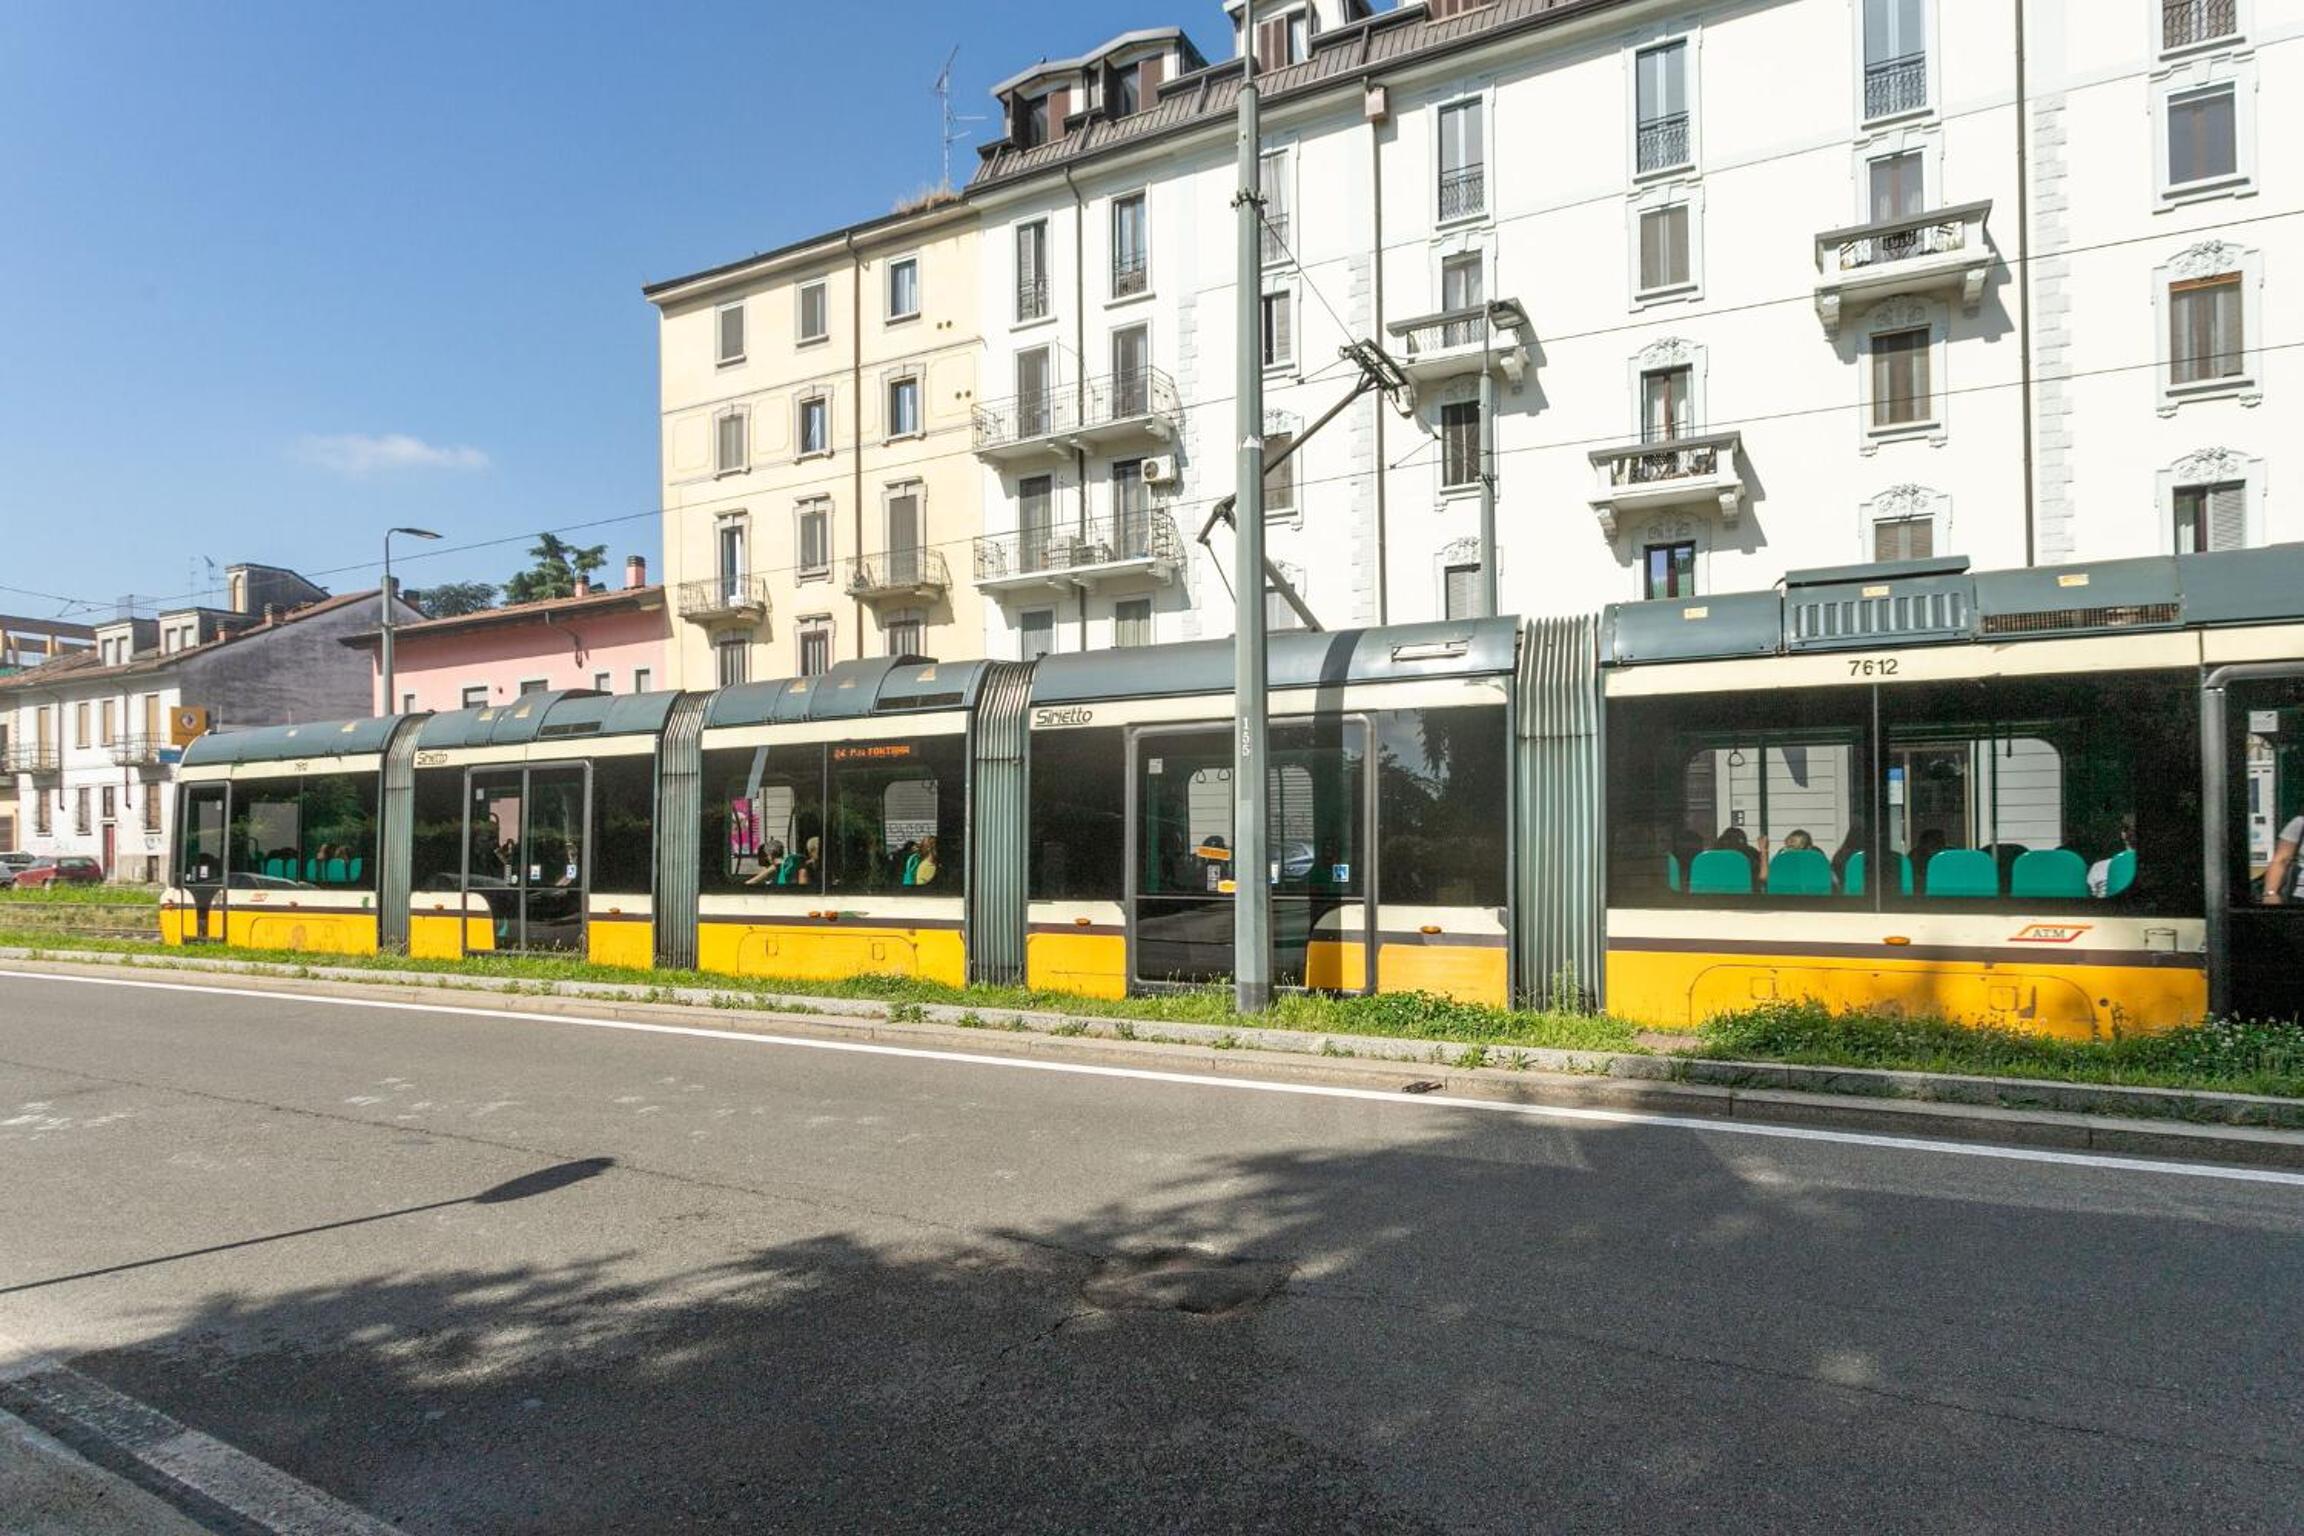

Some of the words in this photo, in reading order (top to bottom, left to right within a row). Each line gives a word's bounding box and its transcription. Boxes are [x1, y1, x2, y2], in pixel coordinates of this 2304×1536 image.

[1848, 658, 1899, 676] 7612
[1035, 707, 1093, 726] Sirietto
[1242, 717, 1250, 757] 155
[2033, 928, 2066, 938] ATM
